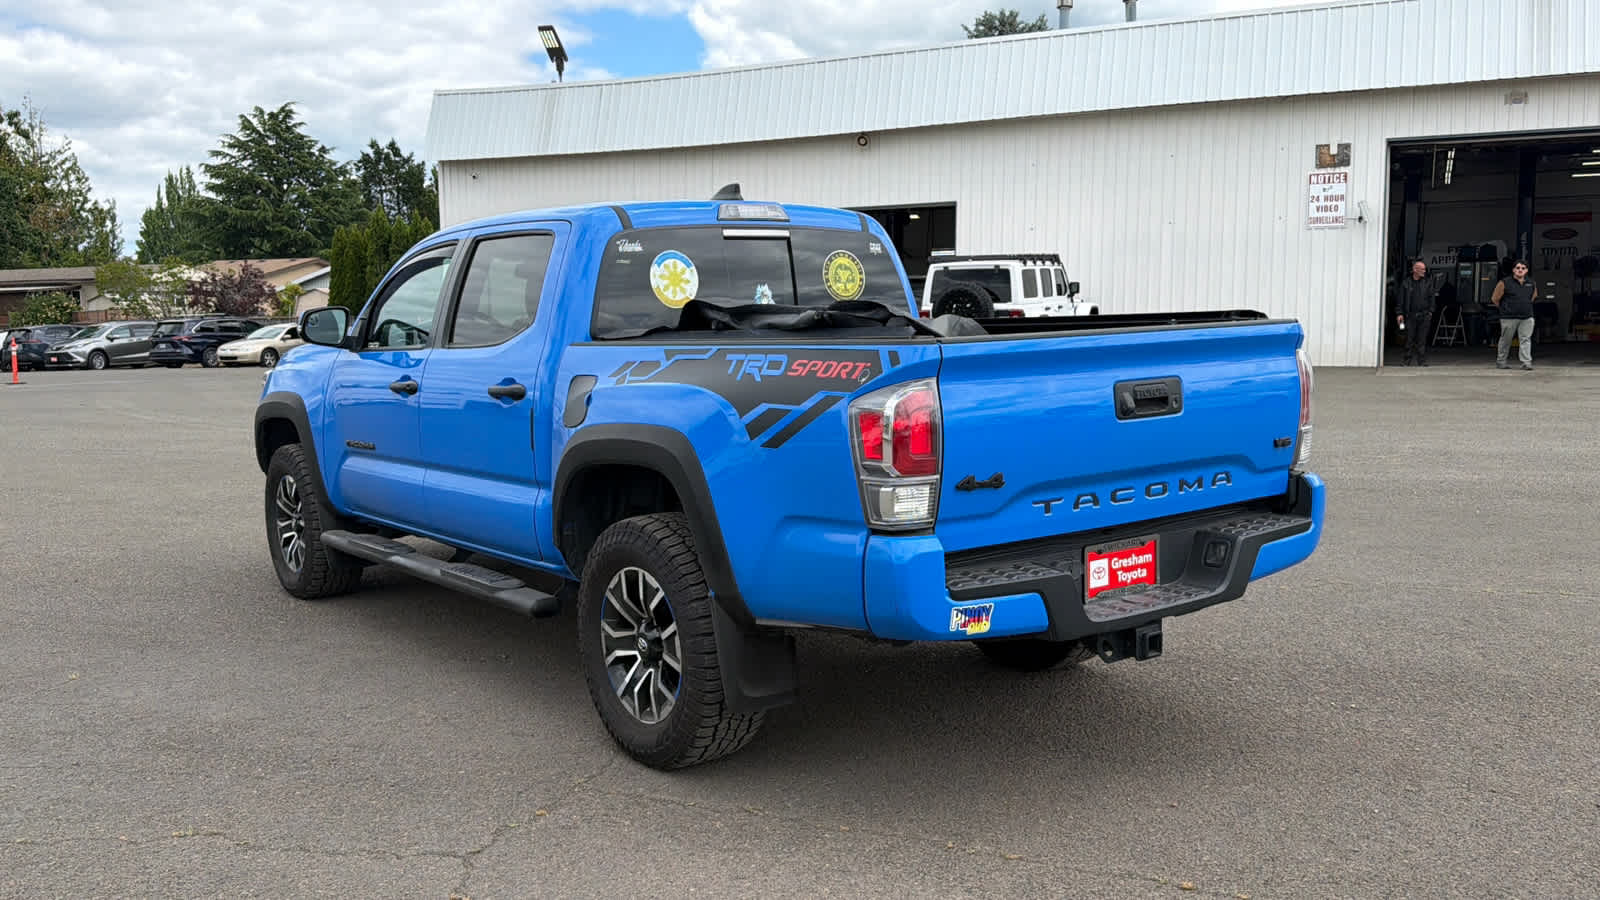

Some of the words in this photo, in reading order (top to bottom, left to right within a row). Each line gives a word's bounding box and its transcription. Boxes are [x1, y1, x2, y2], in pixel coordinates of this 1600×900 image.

[1311, 173, 1345, 184] NOTICE
[1310, 195, 1320, 203] 24
[1323, 194, 1345, 202] HOUR
[1315, 204, 1339, 213] VIDEO
[725, 354, 788, 382] TRD
[787, 359, 871, 379] SPORT
[1032, 471, 1234, 516] TACOMA
[1111, 553, 1152, 569] Gresham
[1117, 568, 1147, 584] Toyota
[951, 604, 993, 630] PINOY
